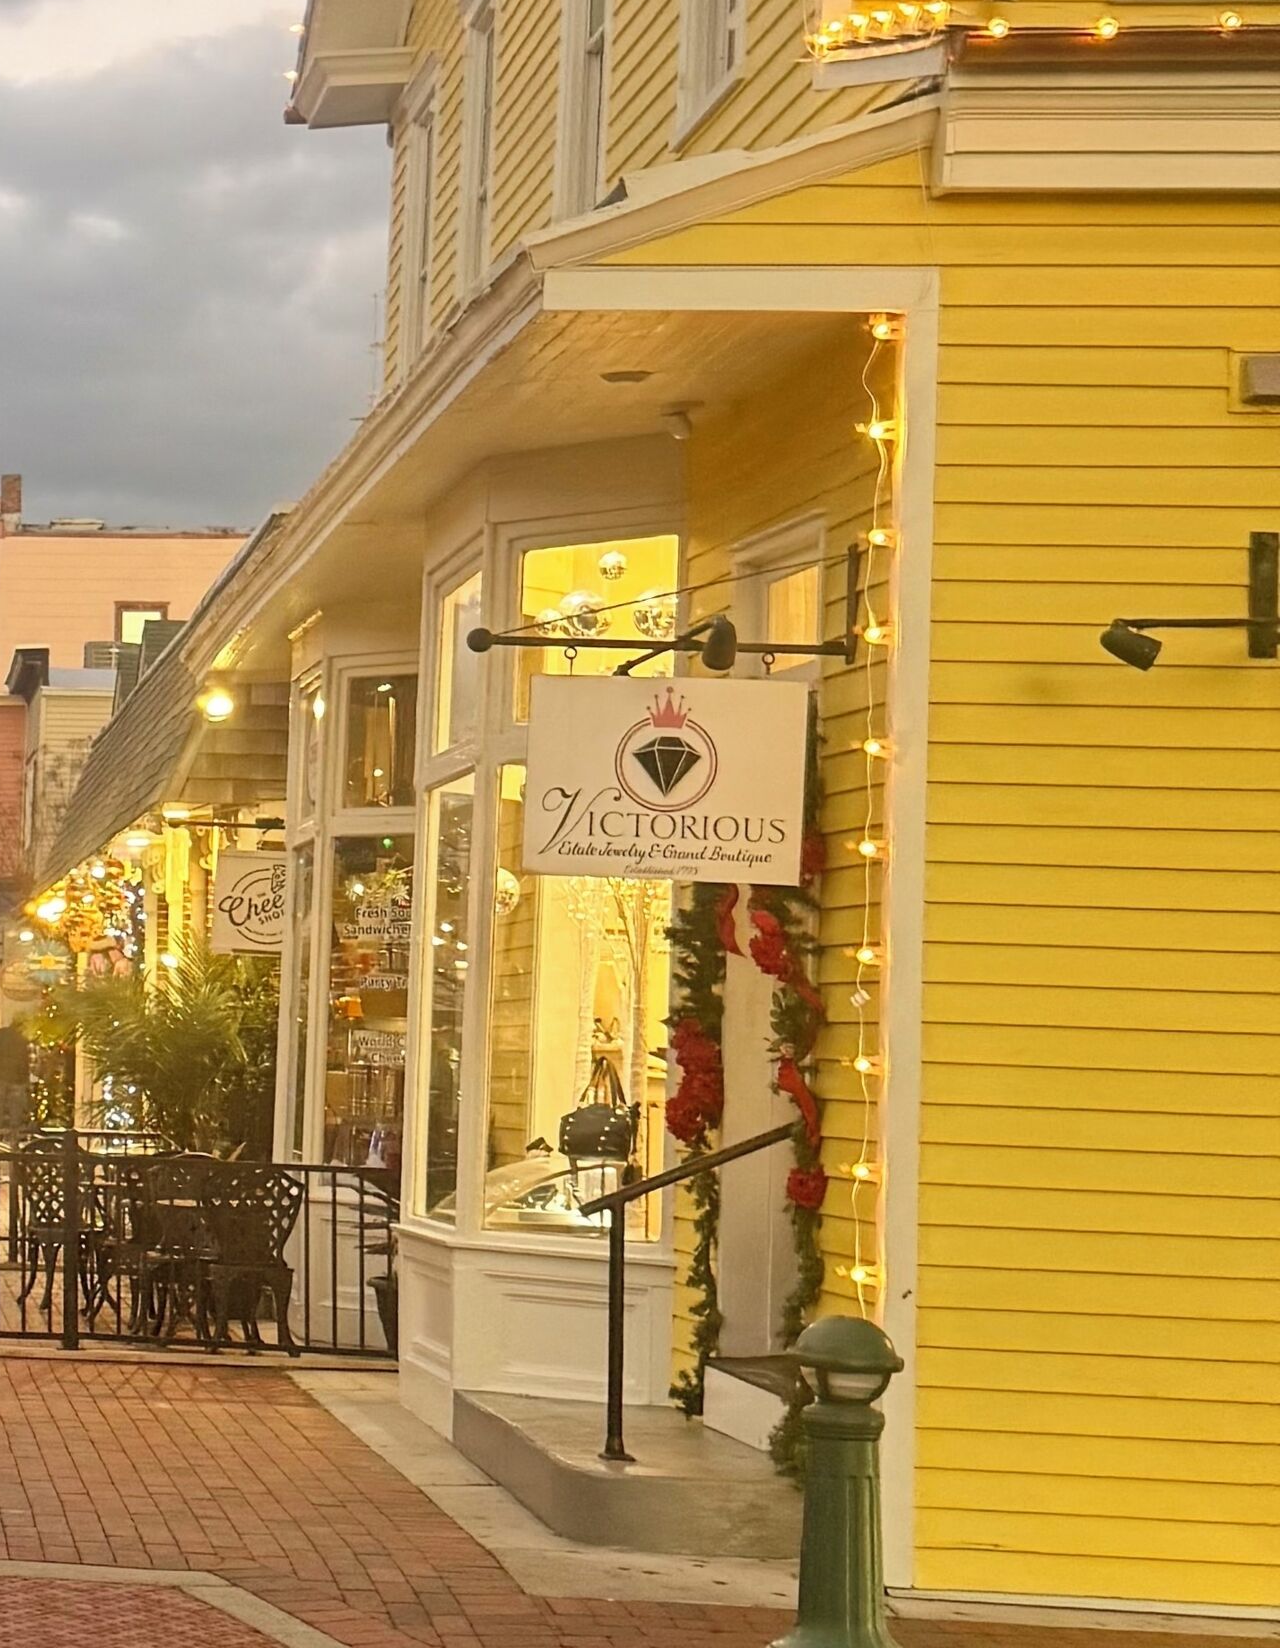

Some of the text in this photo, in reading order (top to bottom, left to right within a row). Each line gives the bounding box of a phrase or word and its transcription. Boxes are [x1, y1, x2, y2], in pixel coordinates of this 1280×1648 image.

[538, 787, 786, 855] VICTORIOUS
[558, 840, 598, 856] Estate
[598, 842, 646, 864] Jewelry
[662, 844, 706, 861] Grand
[708, 846, 772, 868] Boutique
[356, 907, 387, 919] Fresh
